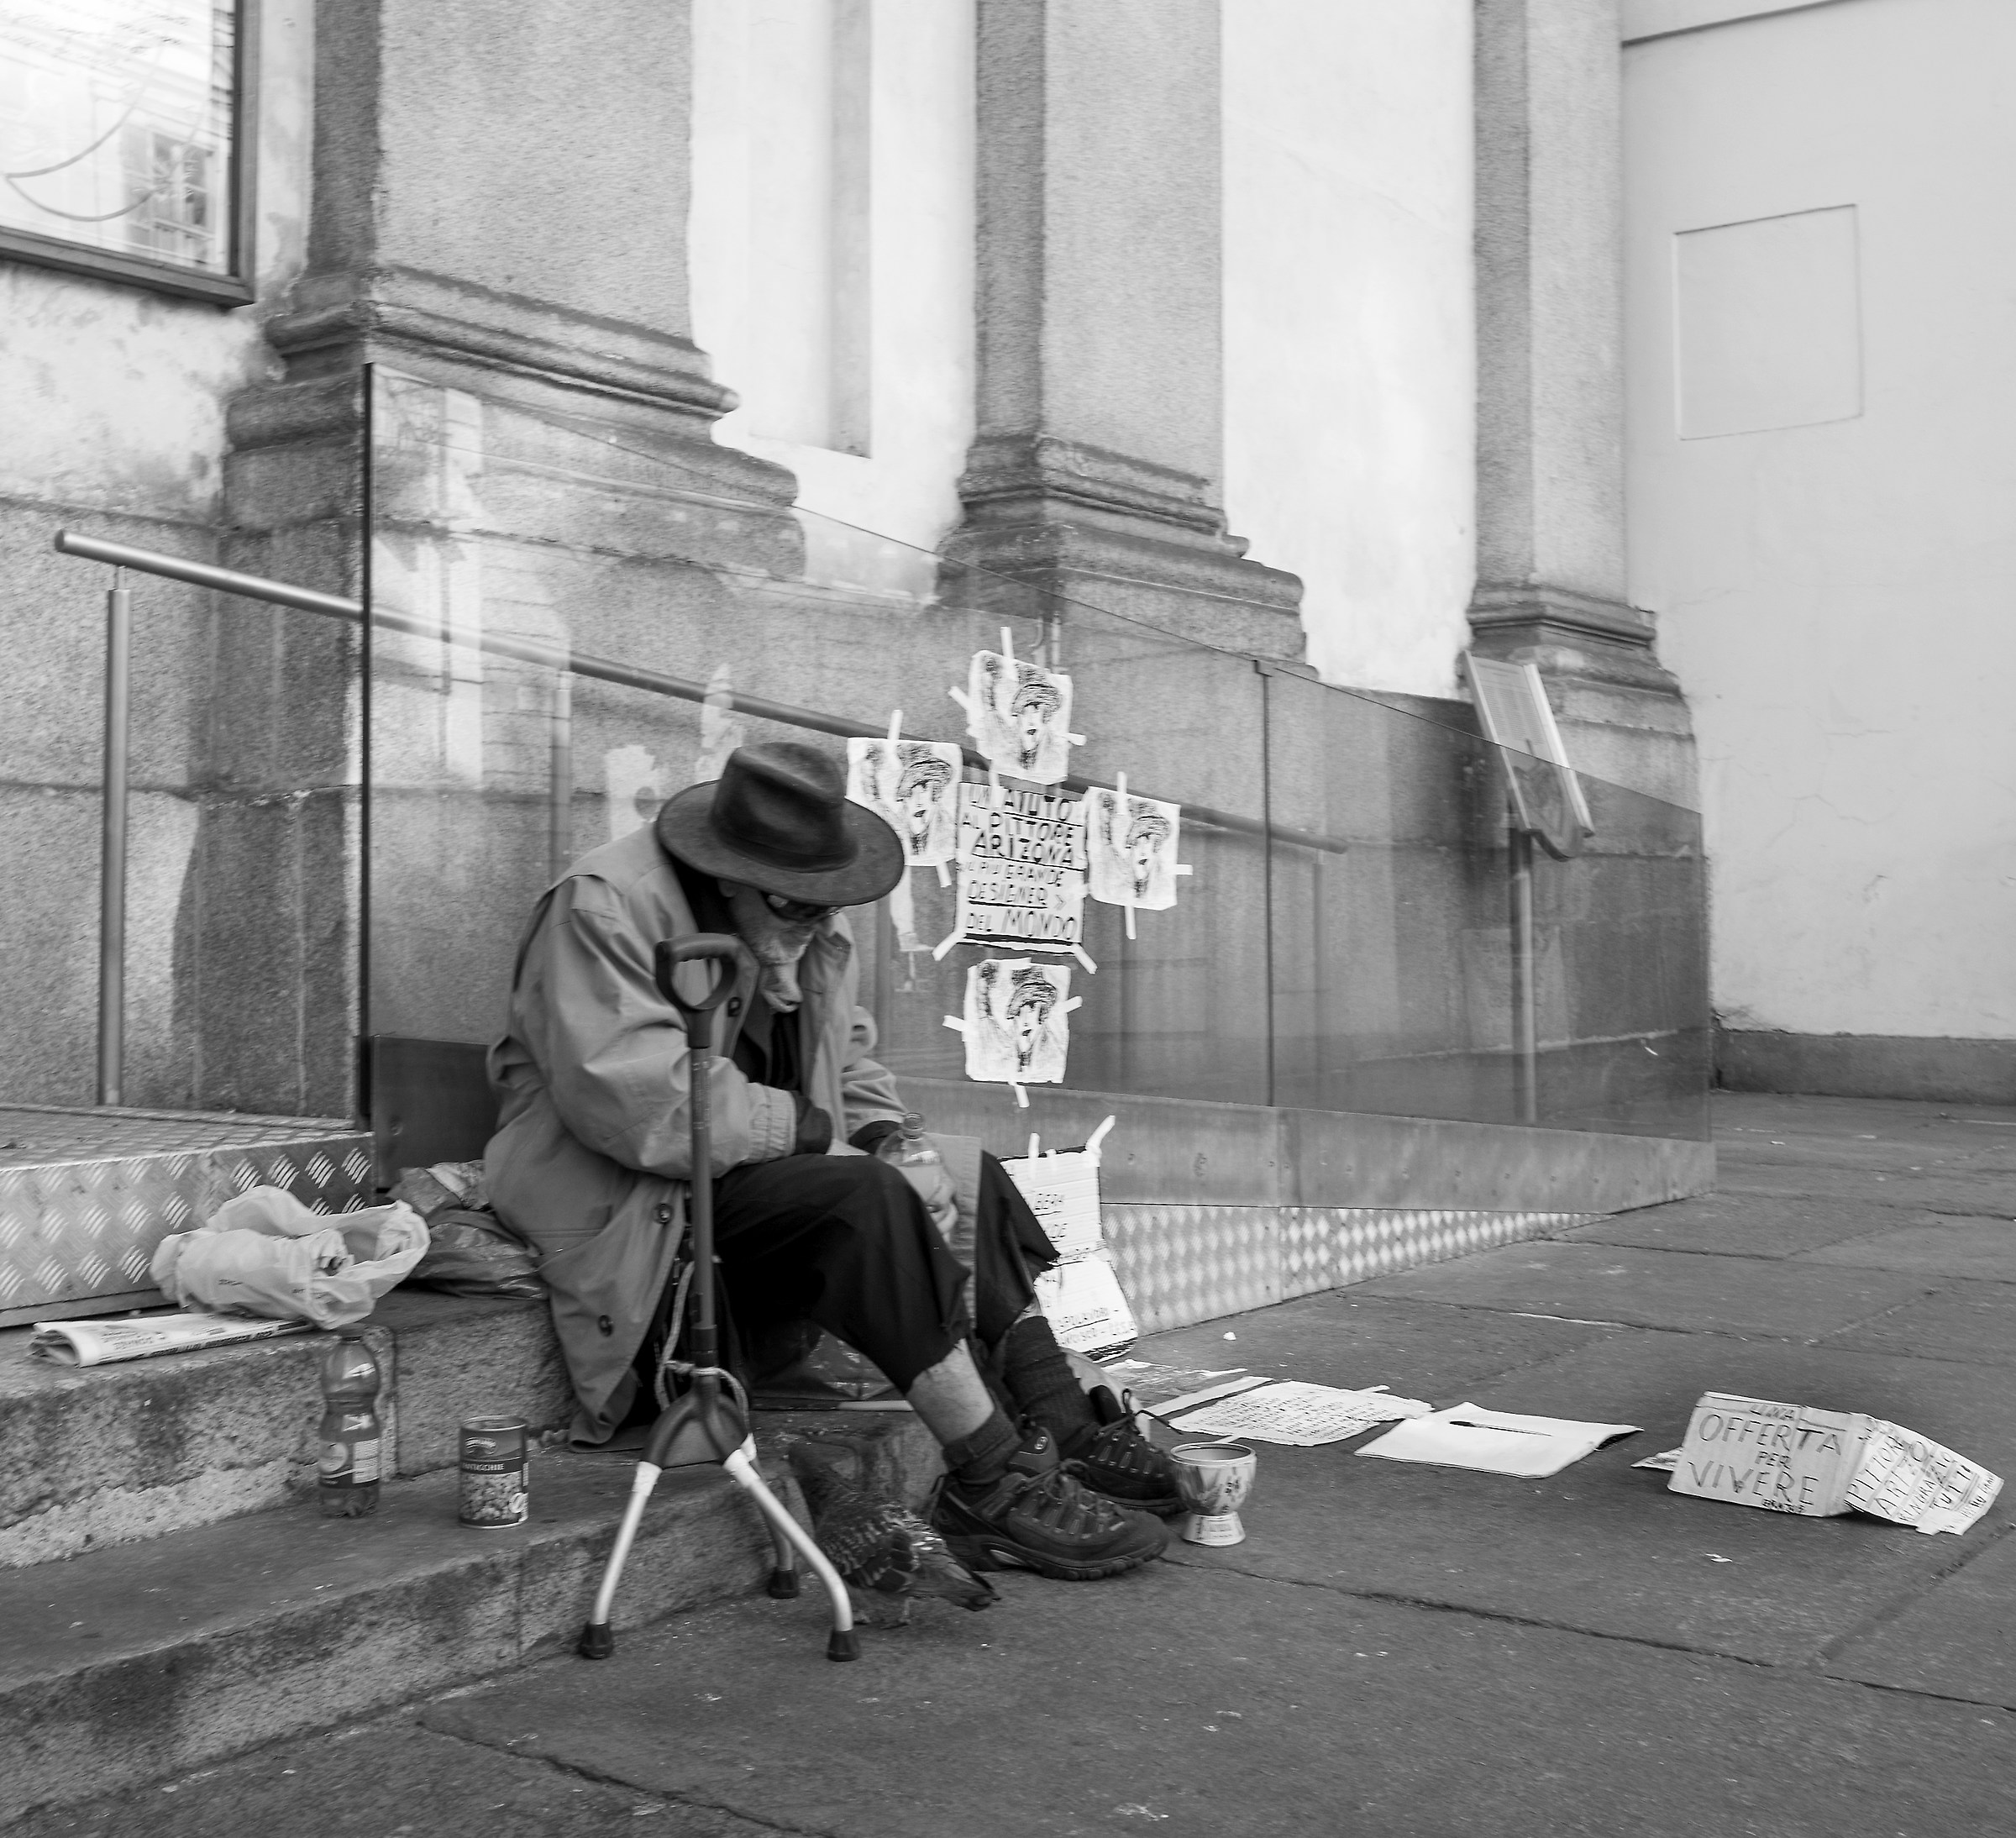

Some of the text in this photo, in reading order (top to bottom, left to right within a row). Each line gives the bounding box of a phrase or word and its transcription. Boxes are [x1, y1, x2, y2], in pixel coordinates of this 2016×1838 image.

[1002, 788, 1074, 822] AIUTO
[989, 811, 1074, 847] PITTORE
[970, 829, 1075, 866] ARIZONA
[965, 907, 1079, 940] DEL MONDO
[1698, 1413, 1842, 1456] OFFERTA
[1754, 1450, 1793, 1470] PER
[1688, 1460, 1819, 1505] VIVERE
